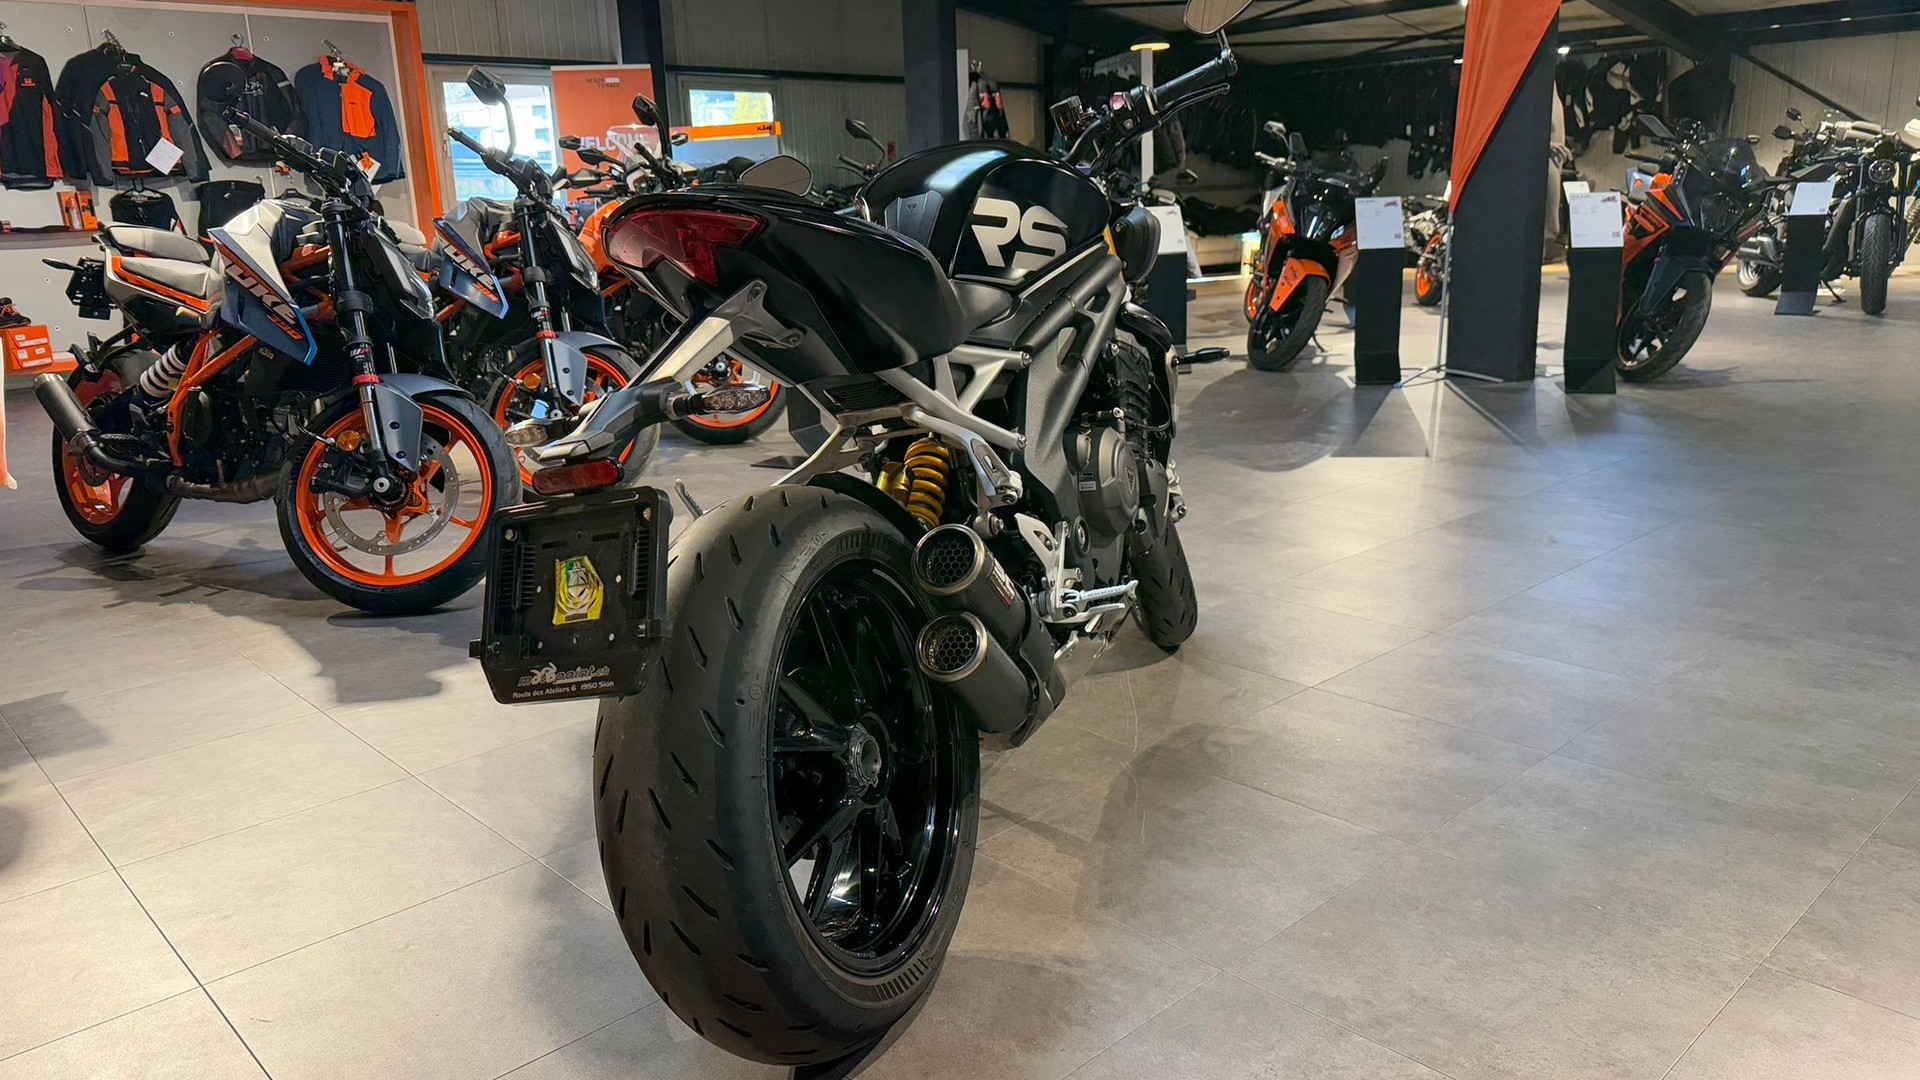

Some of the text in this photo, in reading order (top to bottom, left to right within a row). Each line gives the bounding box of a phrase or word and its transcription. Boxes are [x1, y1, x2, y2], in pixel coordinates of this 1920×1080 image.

[971, 197, 1068, 271] RS
[580, 682, 598, 690] 1950
[598, 680, 614, 688] Sion
